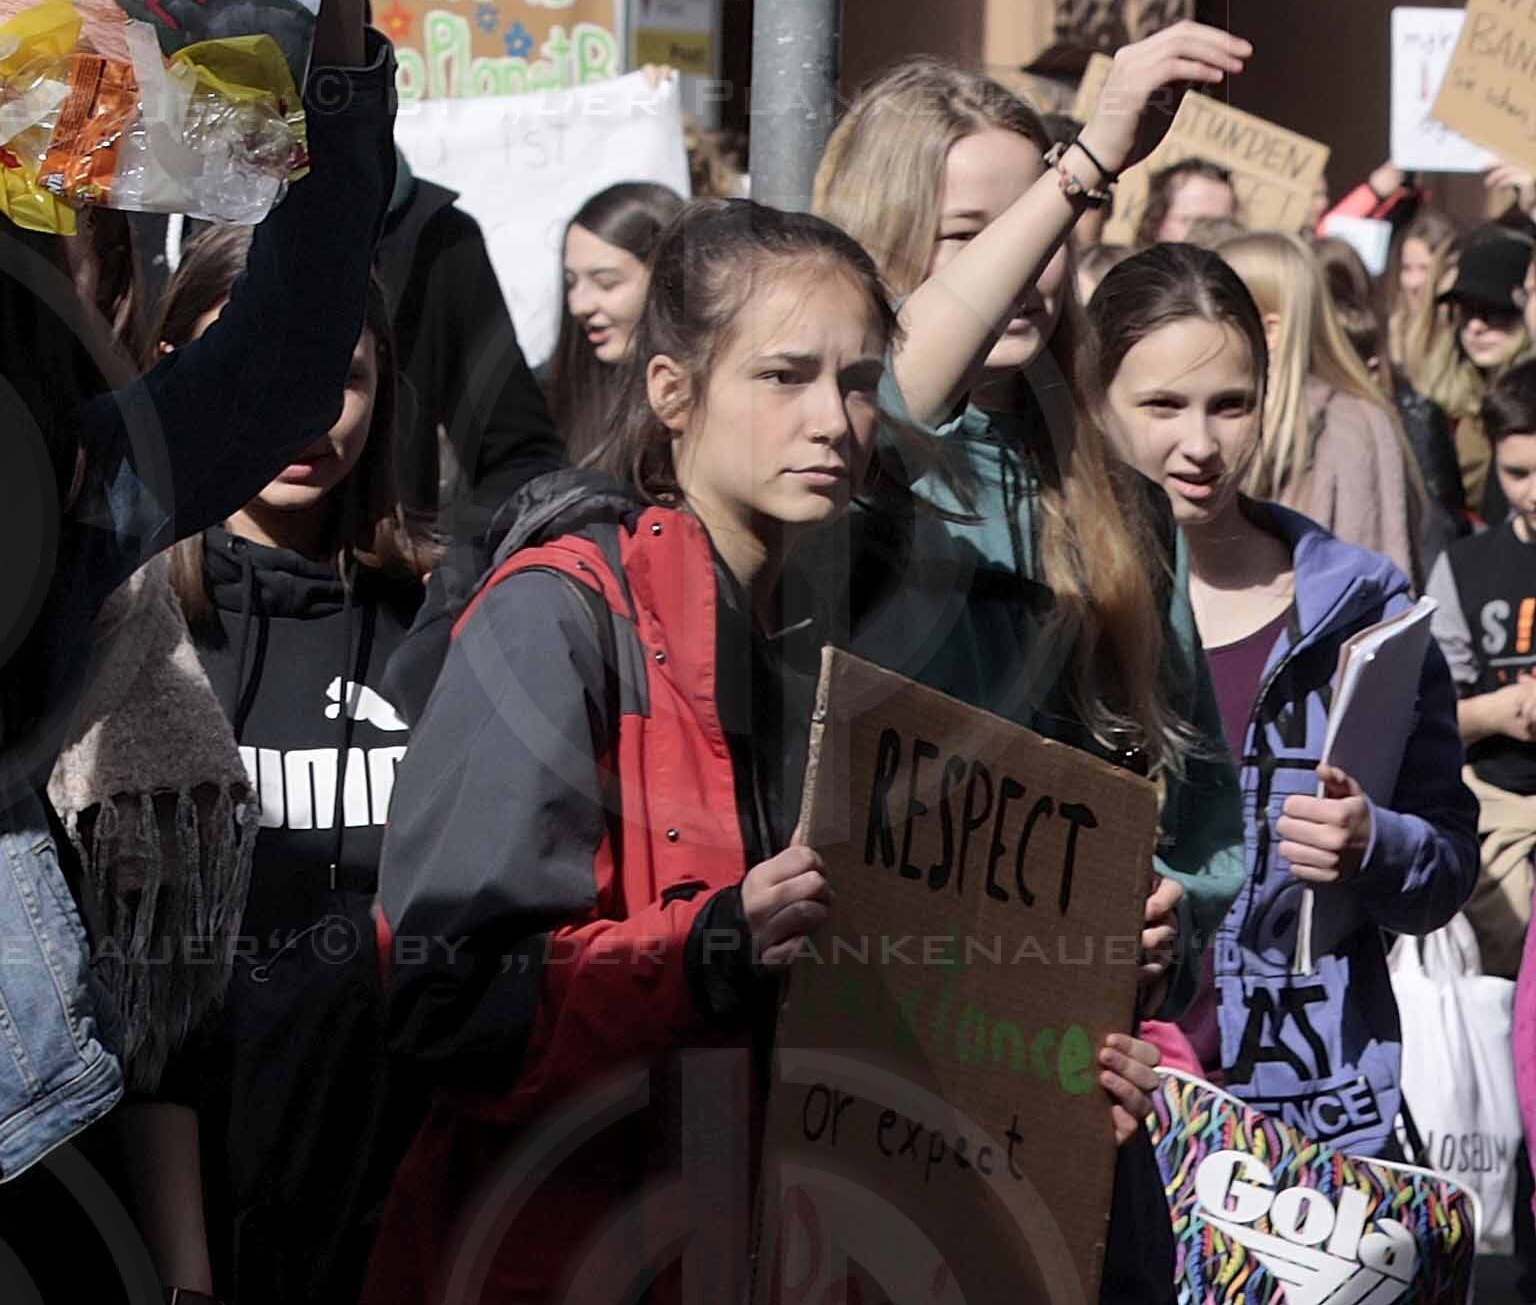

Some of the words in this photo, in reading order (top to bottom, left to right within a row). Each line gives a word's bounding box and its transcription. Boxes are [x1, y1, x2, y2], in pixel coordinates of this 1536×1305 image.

[862, 728, 1098, 918] RESPECT
[802, 1079, 854, 1147] or
[875, 1114, 1028, 1183] expect
[1193, 1149, 1419, 1286] Gola
